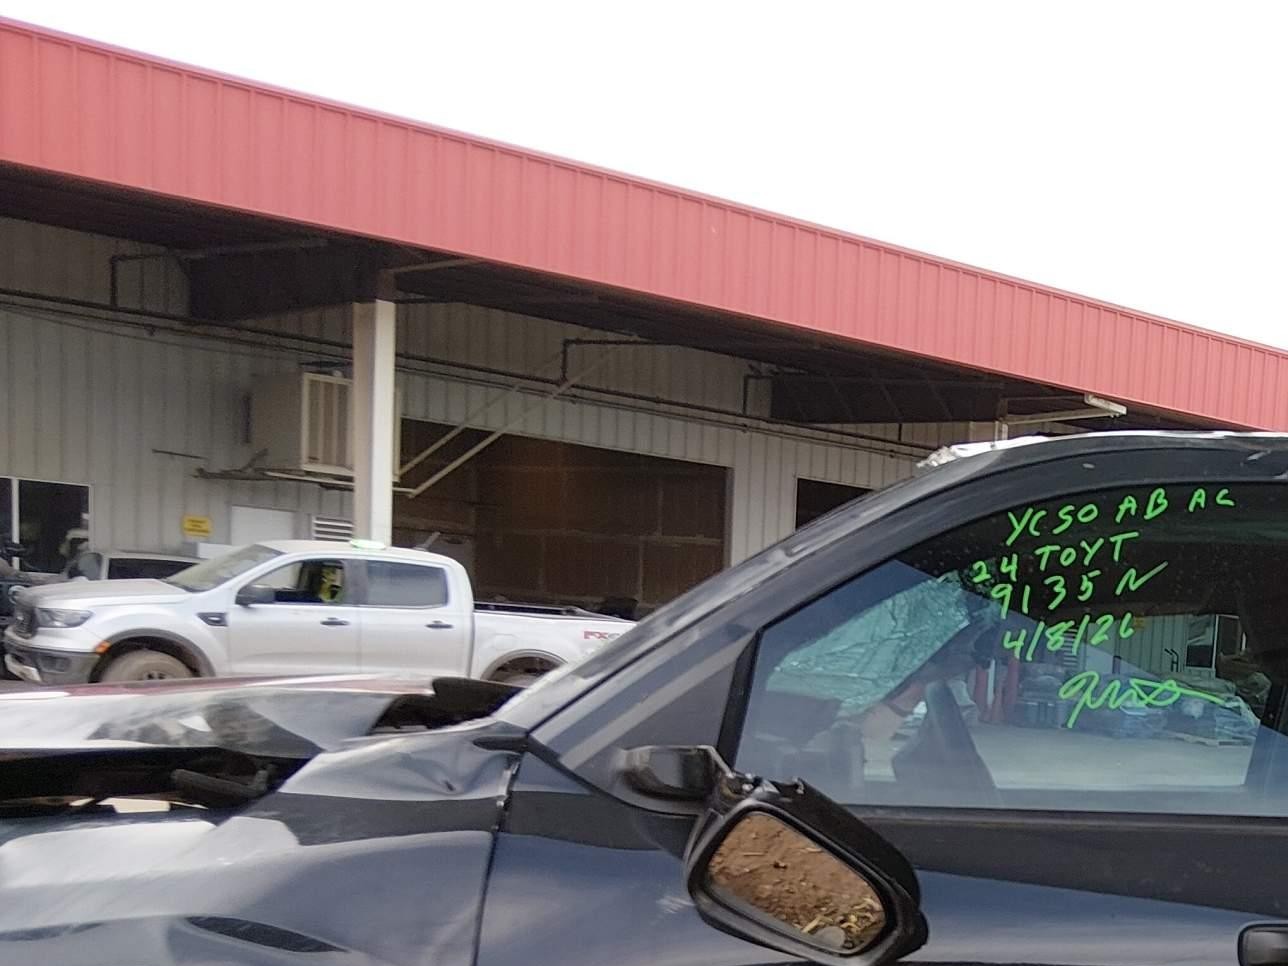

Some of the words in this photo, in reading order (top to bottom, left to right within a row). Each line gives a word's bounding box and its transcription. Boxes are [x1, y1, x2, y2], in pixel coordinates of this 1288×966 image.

[1006, 503, 1099, 546] YCSO
[1115, 488, 1169, 523] AB
[971, 553, 1019, 583] 24
[1034, 531, 1140, 572] TOYT
[1003, 611, 1135, 662] 4/8/26
